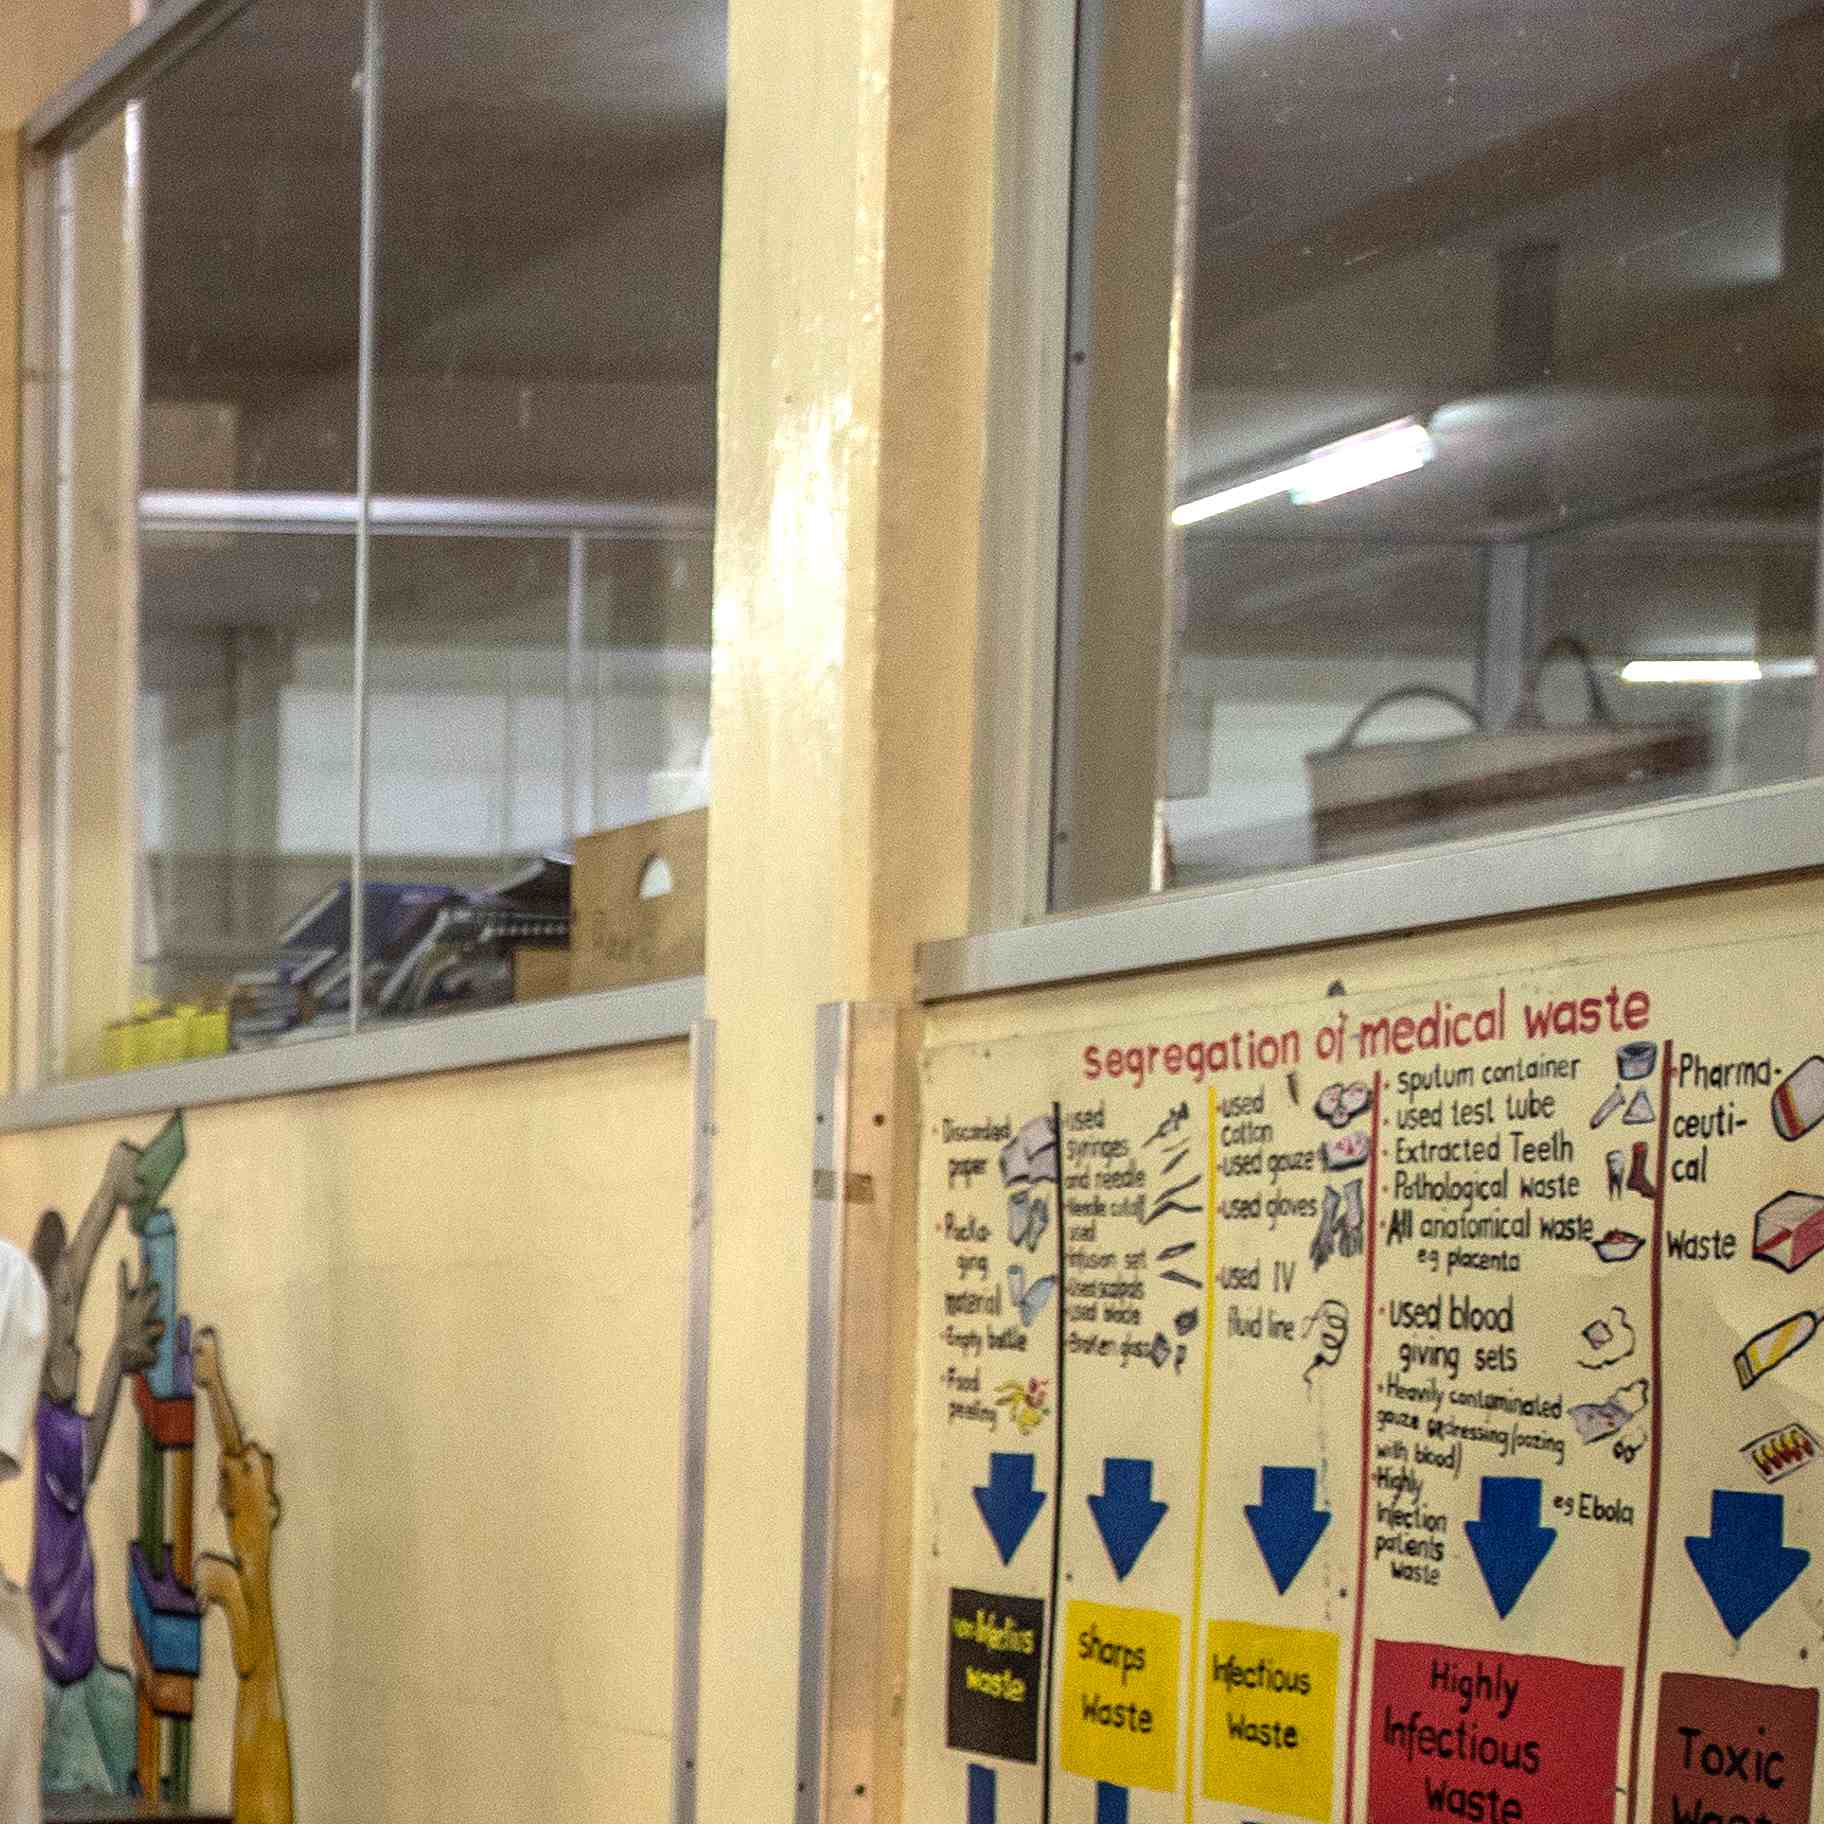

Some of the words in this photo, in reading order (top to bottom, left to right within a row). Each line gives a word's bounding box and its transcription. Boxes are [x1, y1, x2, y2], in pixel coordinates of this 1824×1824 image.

[1315, 1011, 1348, 1062] of
[1359, 987, 1504, 1057] medical
[1524, 984, 1650, 1039] waste
[1482, 1053, 1582, 1085] container
[1396, 1098, 1442, 1130] used
[1452, 1096, 1496, 1126] test
[1504, 1088, 1557, 1120] tube
[1673, 1101, 1749, 1139] ceuti-
[1222, 1150, 1263, 1177] used
[1394, 1132, 1501, 1165] Extracted
[1509, 1127, 1574, 1165] Teeth
[1670, 1143, 1710, 1184] cal
[1393, 1166, 1509, 1210] Pathological
[1222, 1191, 1261, 1220] used
[1265, 1187, 1318, 1231] gloves
[1386, 1208, 1414, 1247] All
[1420, 1207, 1532, 1241] anatomical
[1219, 1257, 1261, 1291] used
[1446, 1248, 1521, 1276] placenta
[1389, 1293, 1443, 1331] used
[1450, 1293, 1514, 1332] blood
[1398, 1341, 1461, 1380] giving
[1474, 1344, 1518, 1372] sets
[1386, 1371, 1445, 1413] Heavily
[1450, 1386, 1564, 1420] contaminated
[1376, 1464, 1424, 1504] Highly
[1578, 1491, 1634, 1527] Ebola
[1374, 1531, 1445, 1562] patients
[1429, 1657, 1520, 1721] Highly
[1382, 1703, 1542, 1776] Infectious
[1677, 1724, 1787, 1792] Toxic
